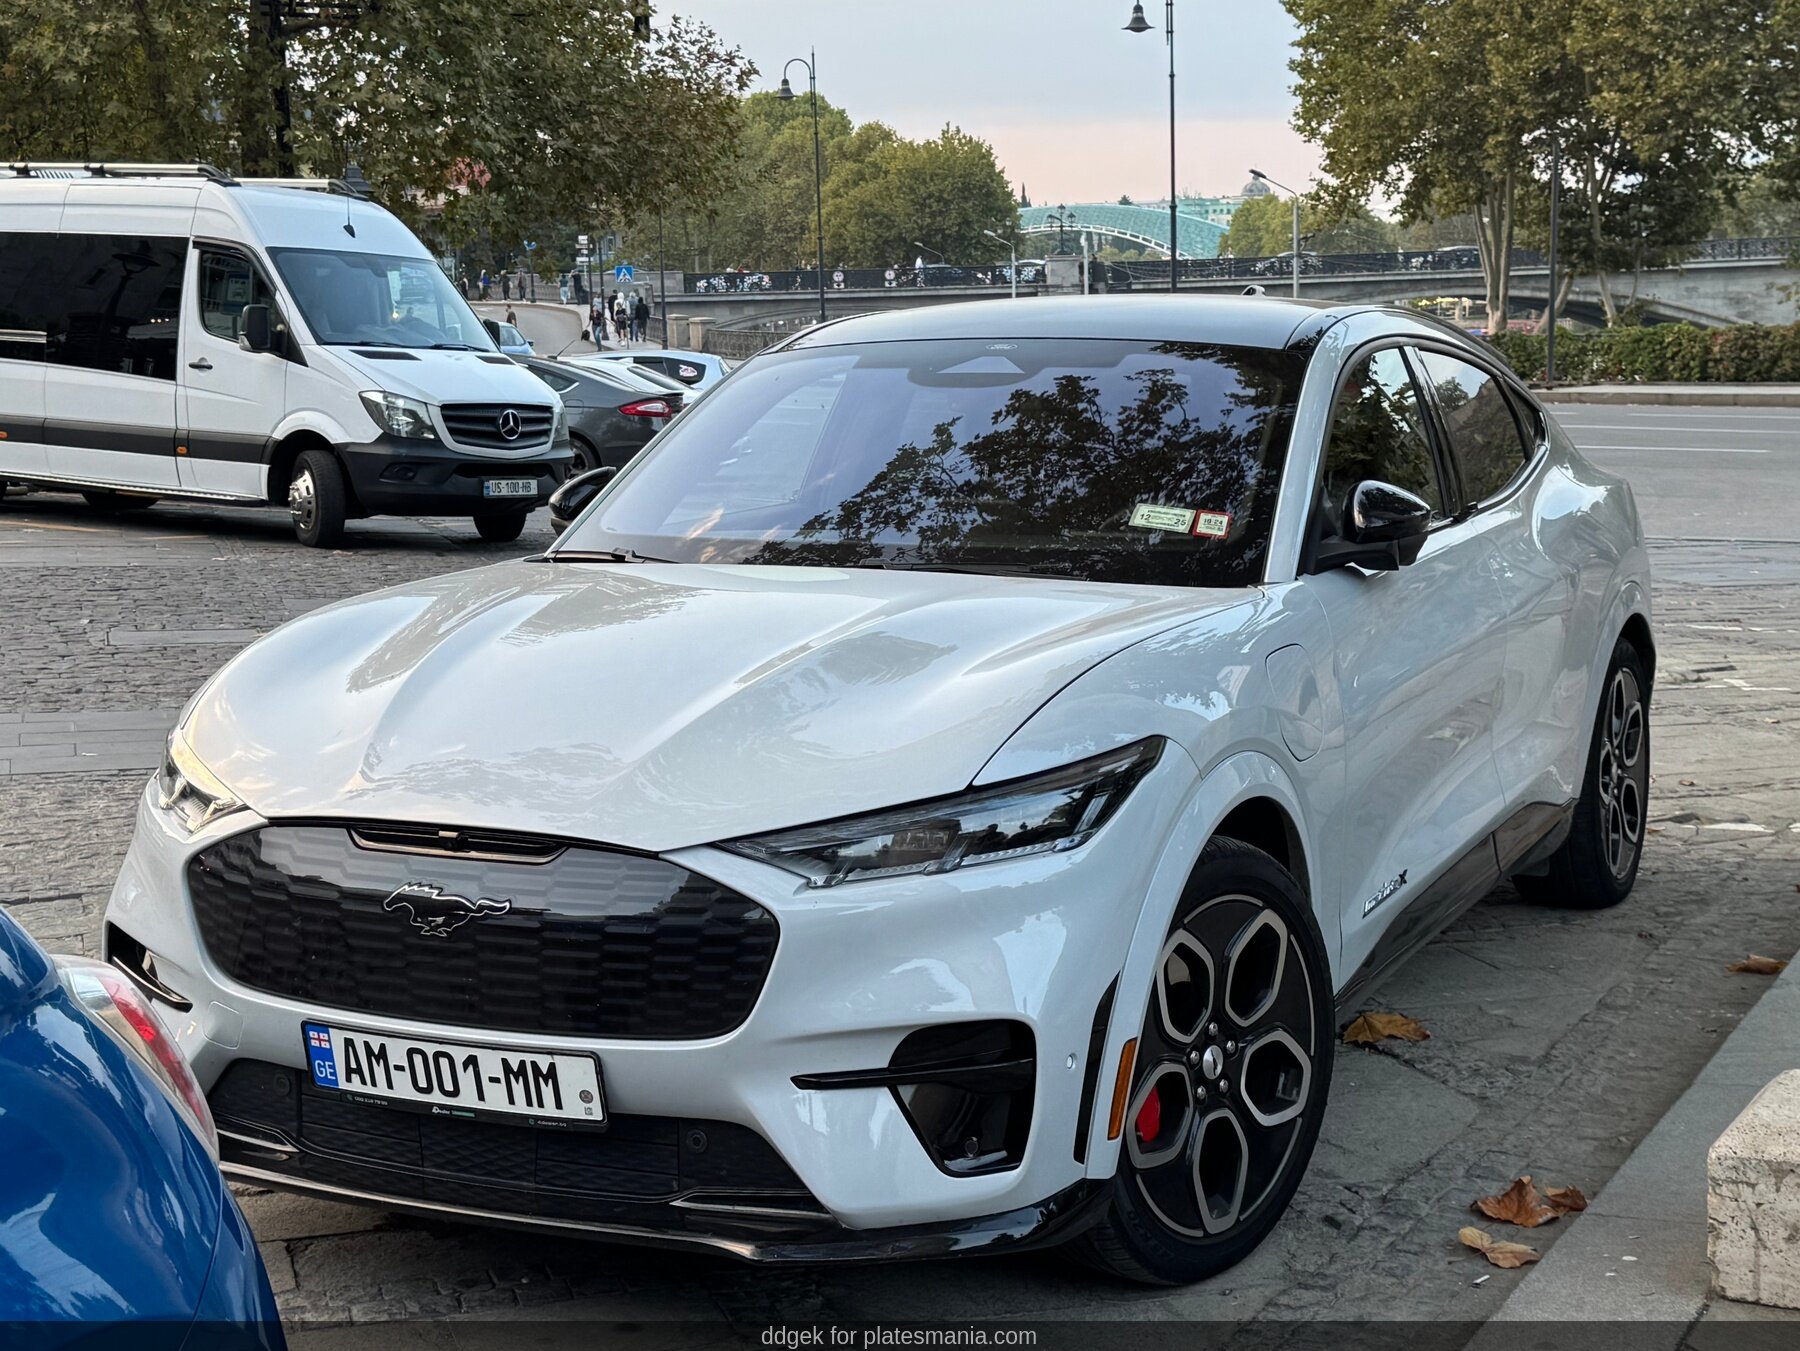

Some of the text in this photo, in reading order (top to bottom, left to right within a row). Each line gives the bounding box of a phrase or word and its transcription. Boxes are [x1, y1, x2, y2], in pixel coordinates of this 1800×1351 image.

[1140, 513, 1152, 521] 12
[1174, 518, 1187, 526] 25
[314, 1060, 337, 1080] GE
[343, 1036, 563, 1110] AM-001-MM
